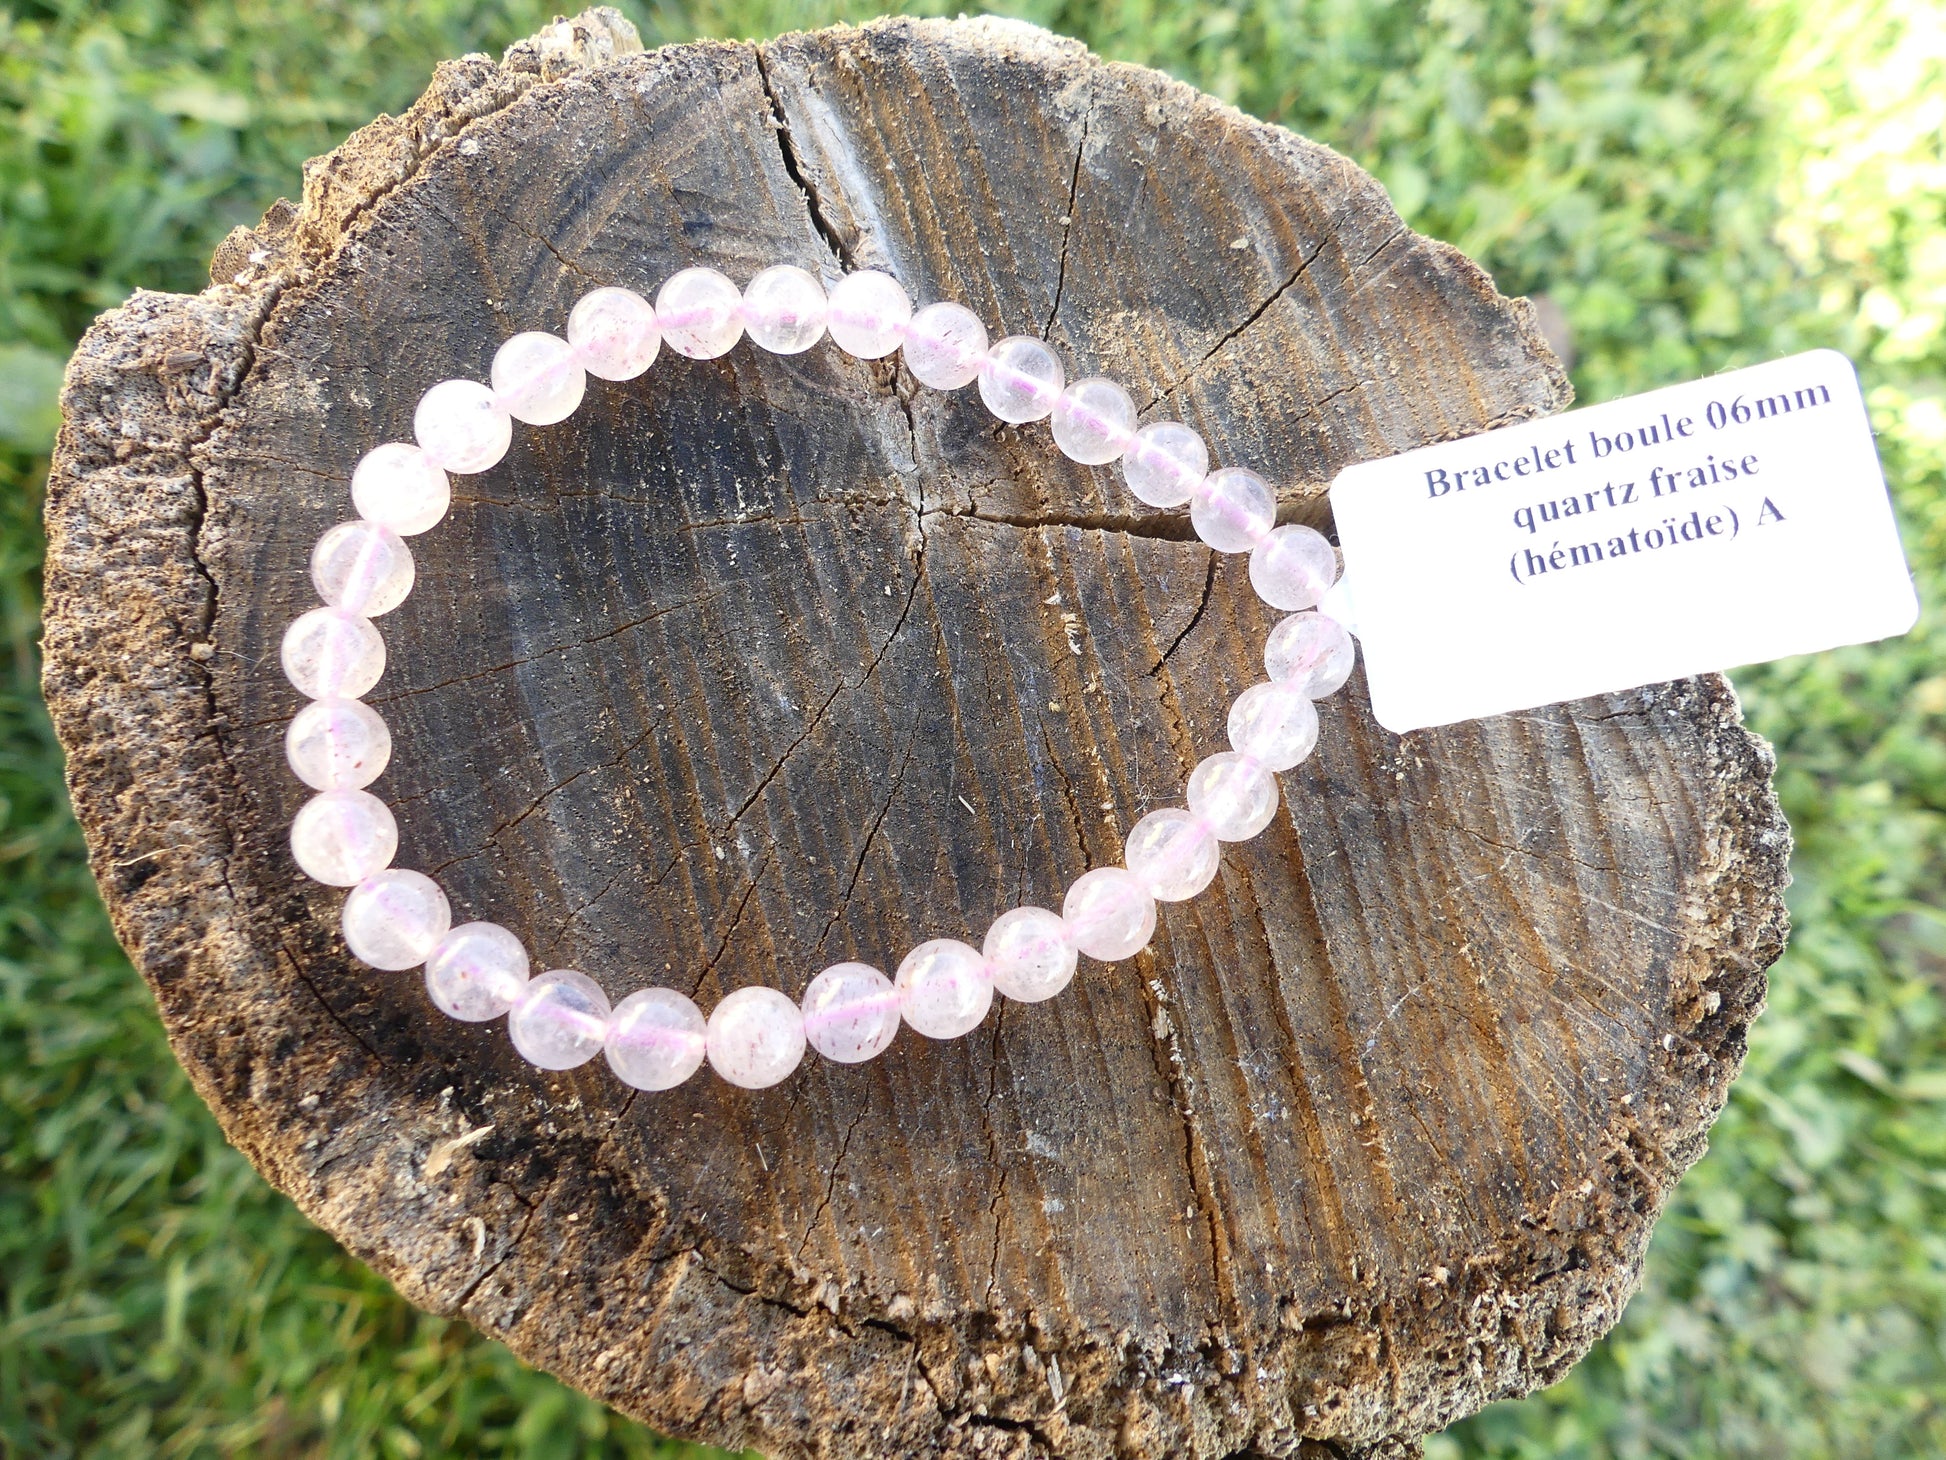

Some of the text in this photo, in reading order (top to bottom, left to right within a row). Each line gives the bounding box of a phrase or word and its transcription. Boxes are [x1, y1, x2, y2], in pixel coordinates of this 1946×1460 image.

[1424, 383, 1831, 499] Bracelet boule 06mm
[1512, 454, 1760, 534] quartz fraise
[1509, 495, 1787, 585] (hématoïde) A
